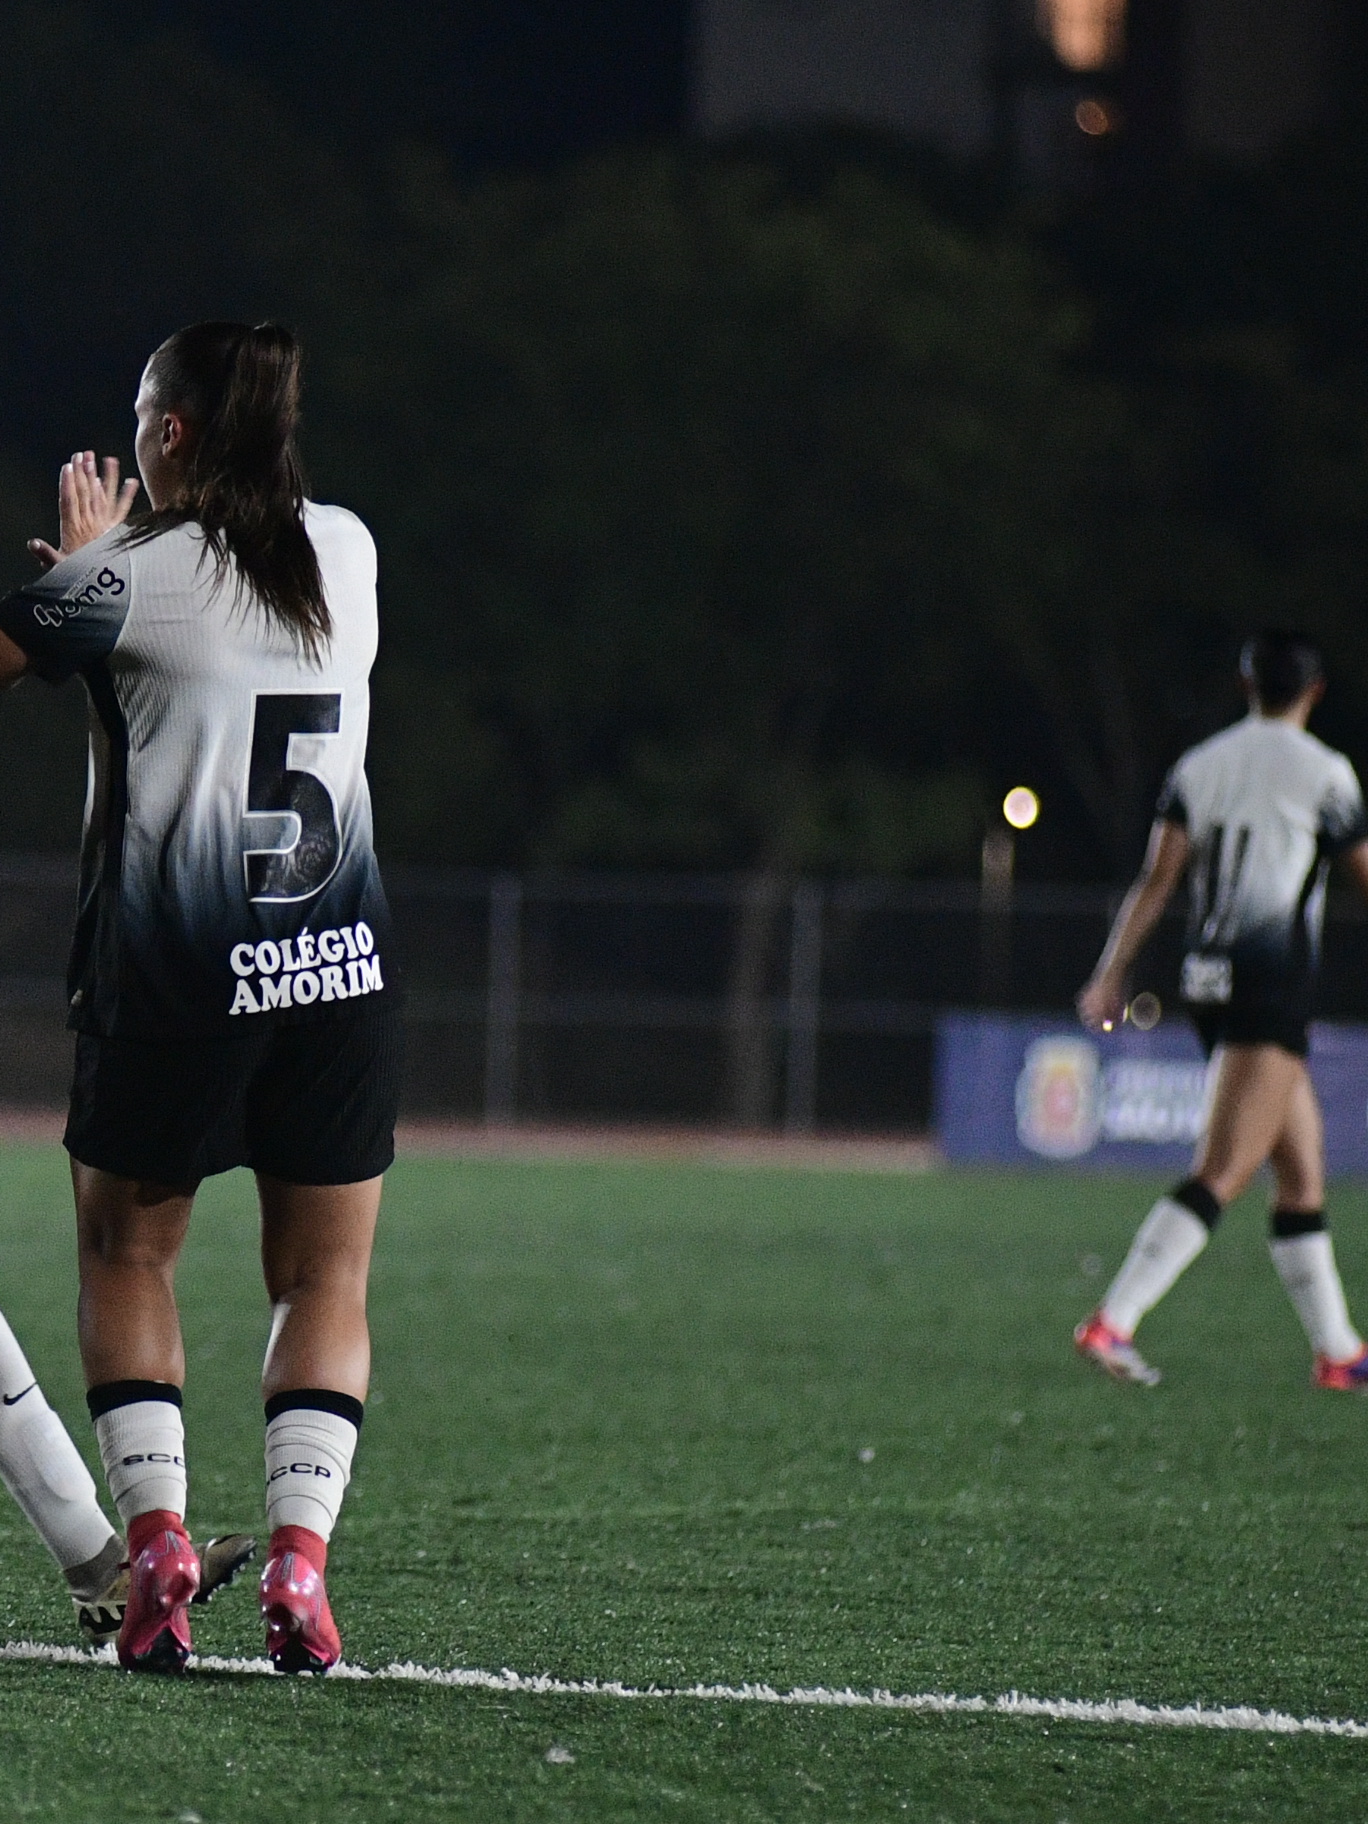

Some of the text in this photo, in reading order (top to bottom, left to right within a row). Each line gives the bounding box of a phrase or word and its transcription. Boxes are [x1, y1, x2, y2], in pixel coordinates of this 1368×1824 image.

[242, 688, 344, 904] 5
[229, 921, 374, 977] COLÉGIO
[228, 954, 384, 1015] AMORIM
